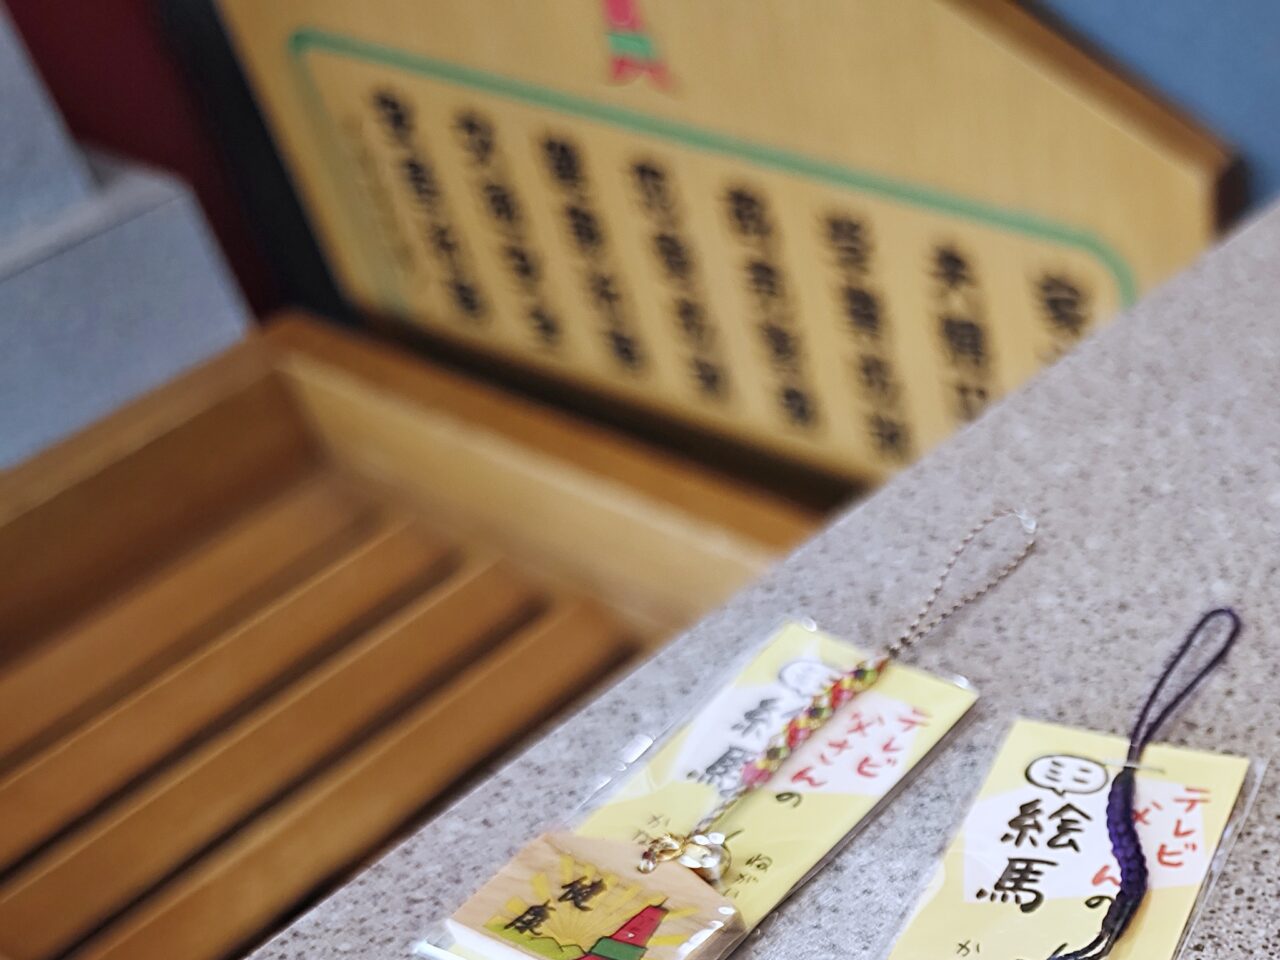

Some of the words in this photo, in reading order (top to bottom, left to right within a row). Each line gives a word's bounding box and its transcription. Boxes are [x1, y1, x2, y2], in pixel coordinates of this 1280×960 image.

[1045, 760, 1091, 784] ミニ
[976, 798, 1093, 913] 絵馬
[1156, 787, 1211, 867] テレビ
